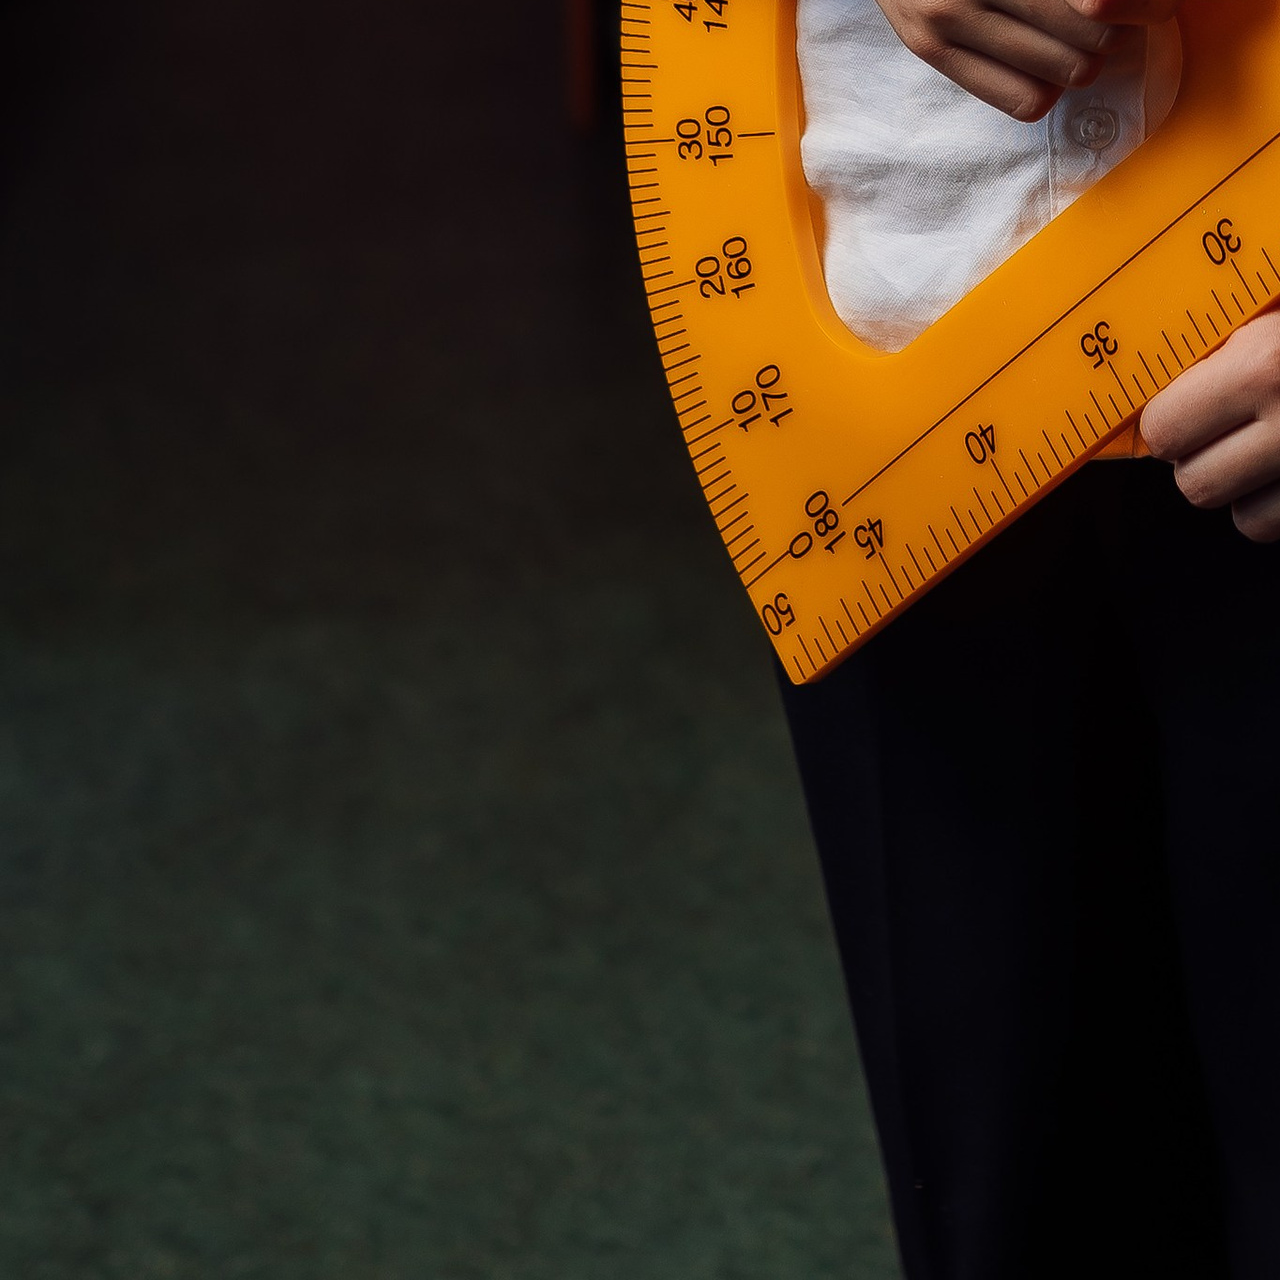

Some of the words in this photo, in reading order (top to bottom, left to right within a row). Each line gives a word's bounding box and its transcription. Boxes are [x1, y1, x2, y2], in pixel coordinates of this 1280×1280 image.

[675, 118, 703, 161] 30
[705, 105, 733, 167] 150
[1202, 218, 1242, 266] 30
[695, 256, 726, 299] 20
[722, 236, 755, 299] 160
[1080, 321, 1119, 369] 35
[731, 390, 761, 432] 10
[756, 364, 793, 426] 170
[965, 423, 997, 464] 40
[805, 490, 846, 556] 180
[854, 517, 885, 560] 45
[788, 532, 814, 560] 0
[762, 593, 796, 636] 50
